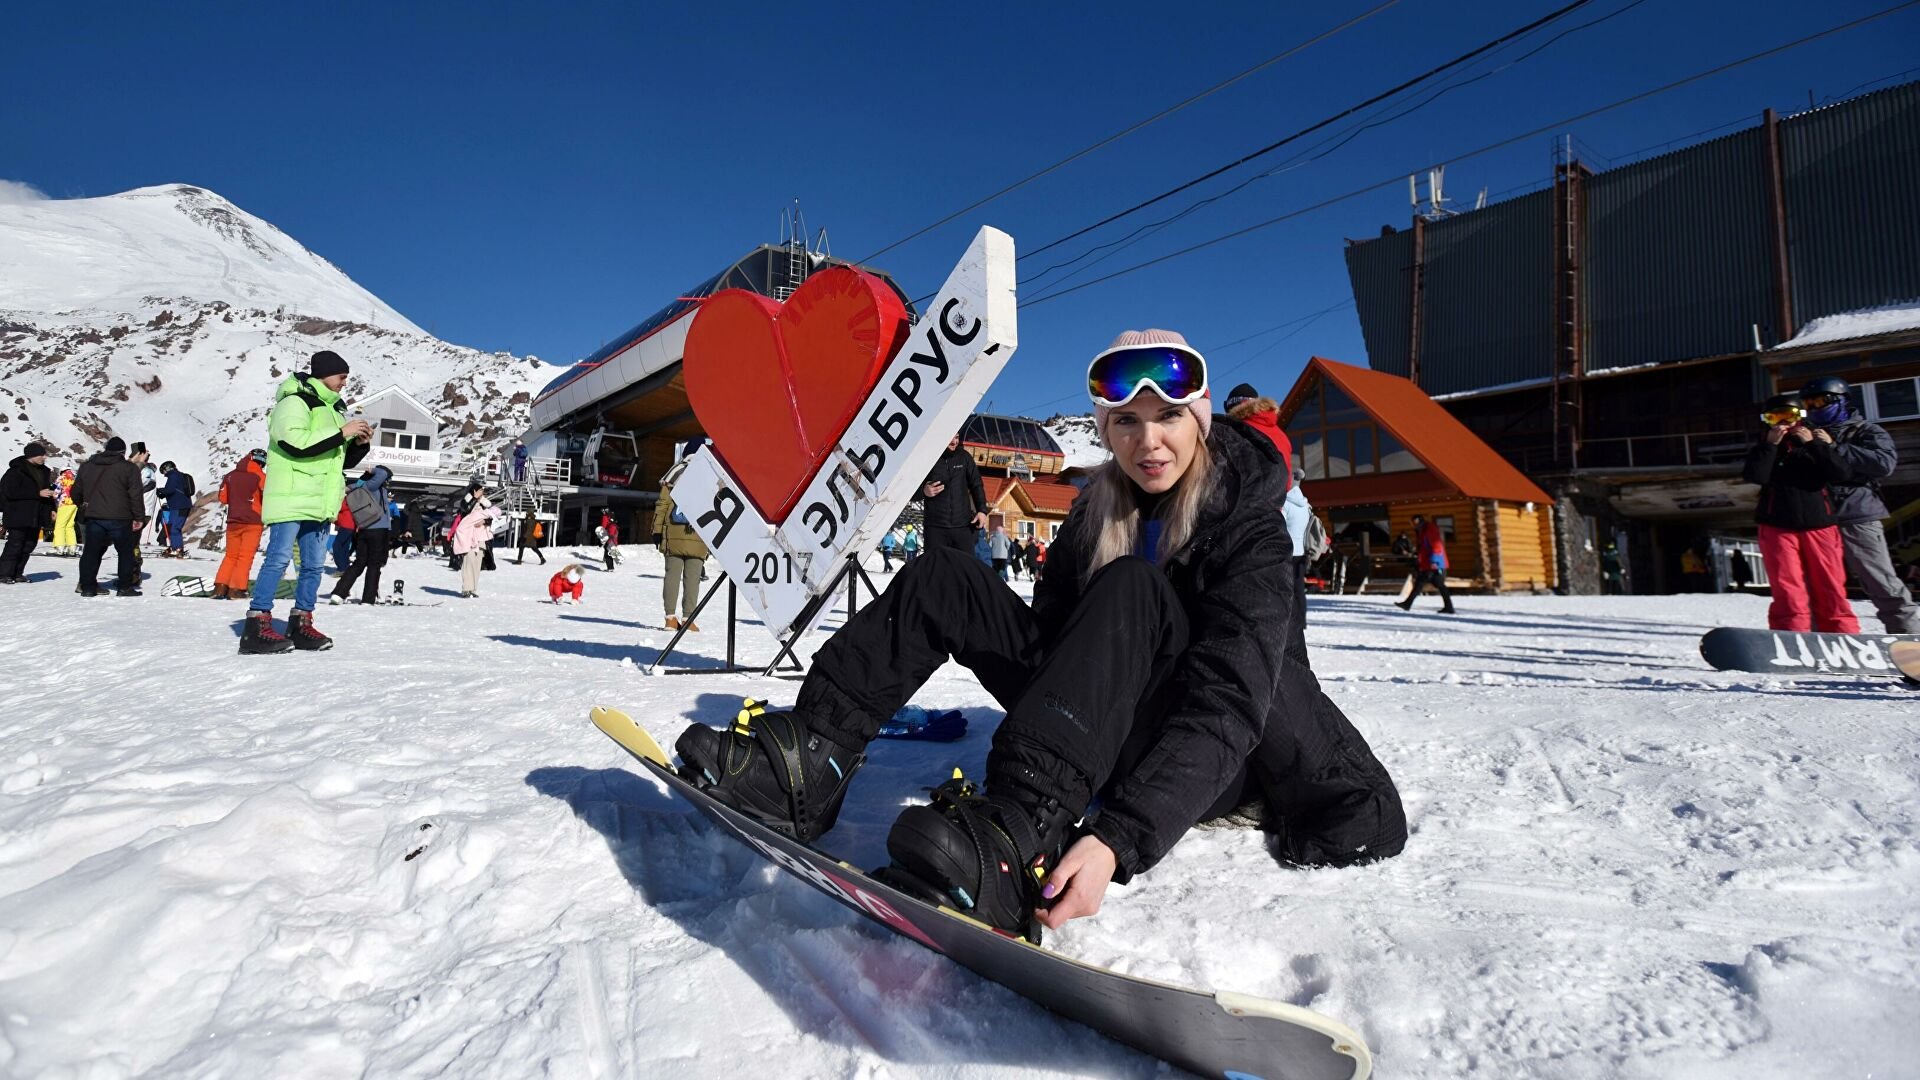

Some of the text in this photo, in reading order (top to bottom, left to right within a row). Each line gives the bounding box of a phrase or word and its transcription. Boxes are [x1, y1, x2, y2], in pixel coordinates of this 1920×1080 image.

[696, 297, 982, 549] Я ЭЛЬБРУС
[378, 450, 422, 464] Эльбрус
[744, 552, 813, 584] 2017
[1769, 633, 1898, 669] RMIT
